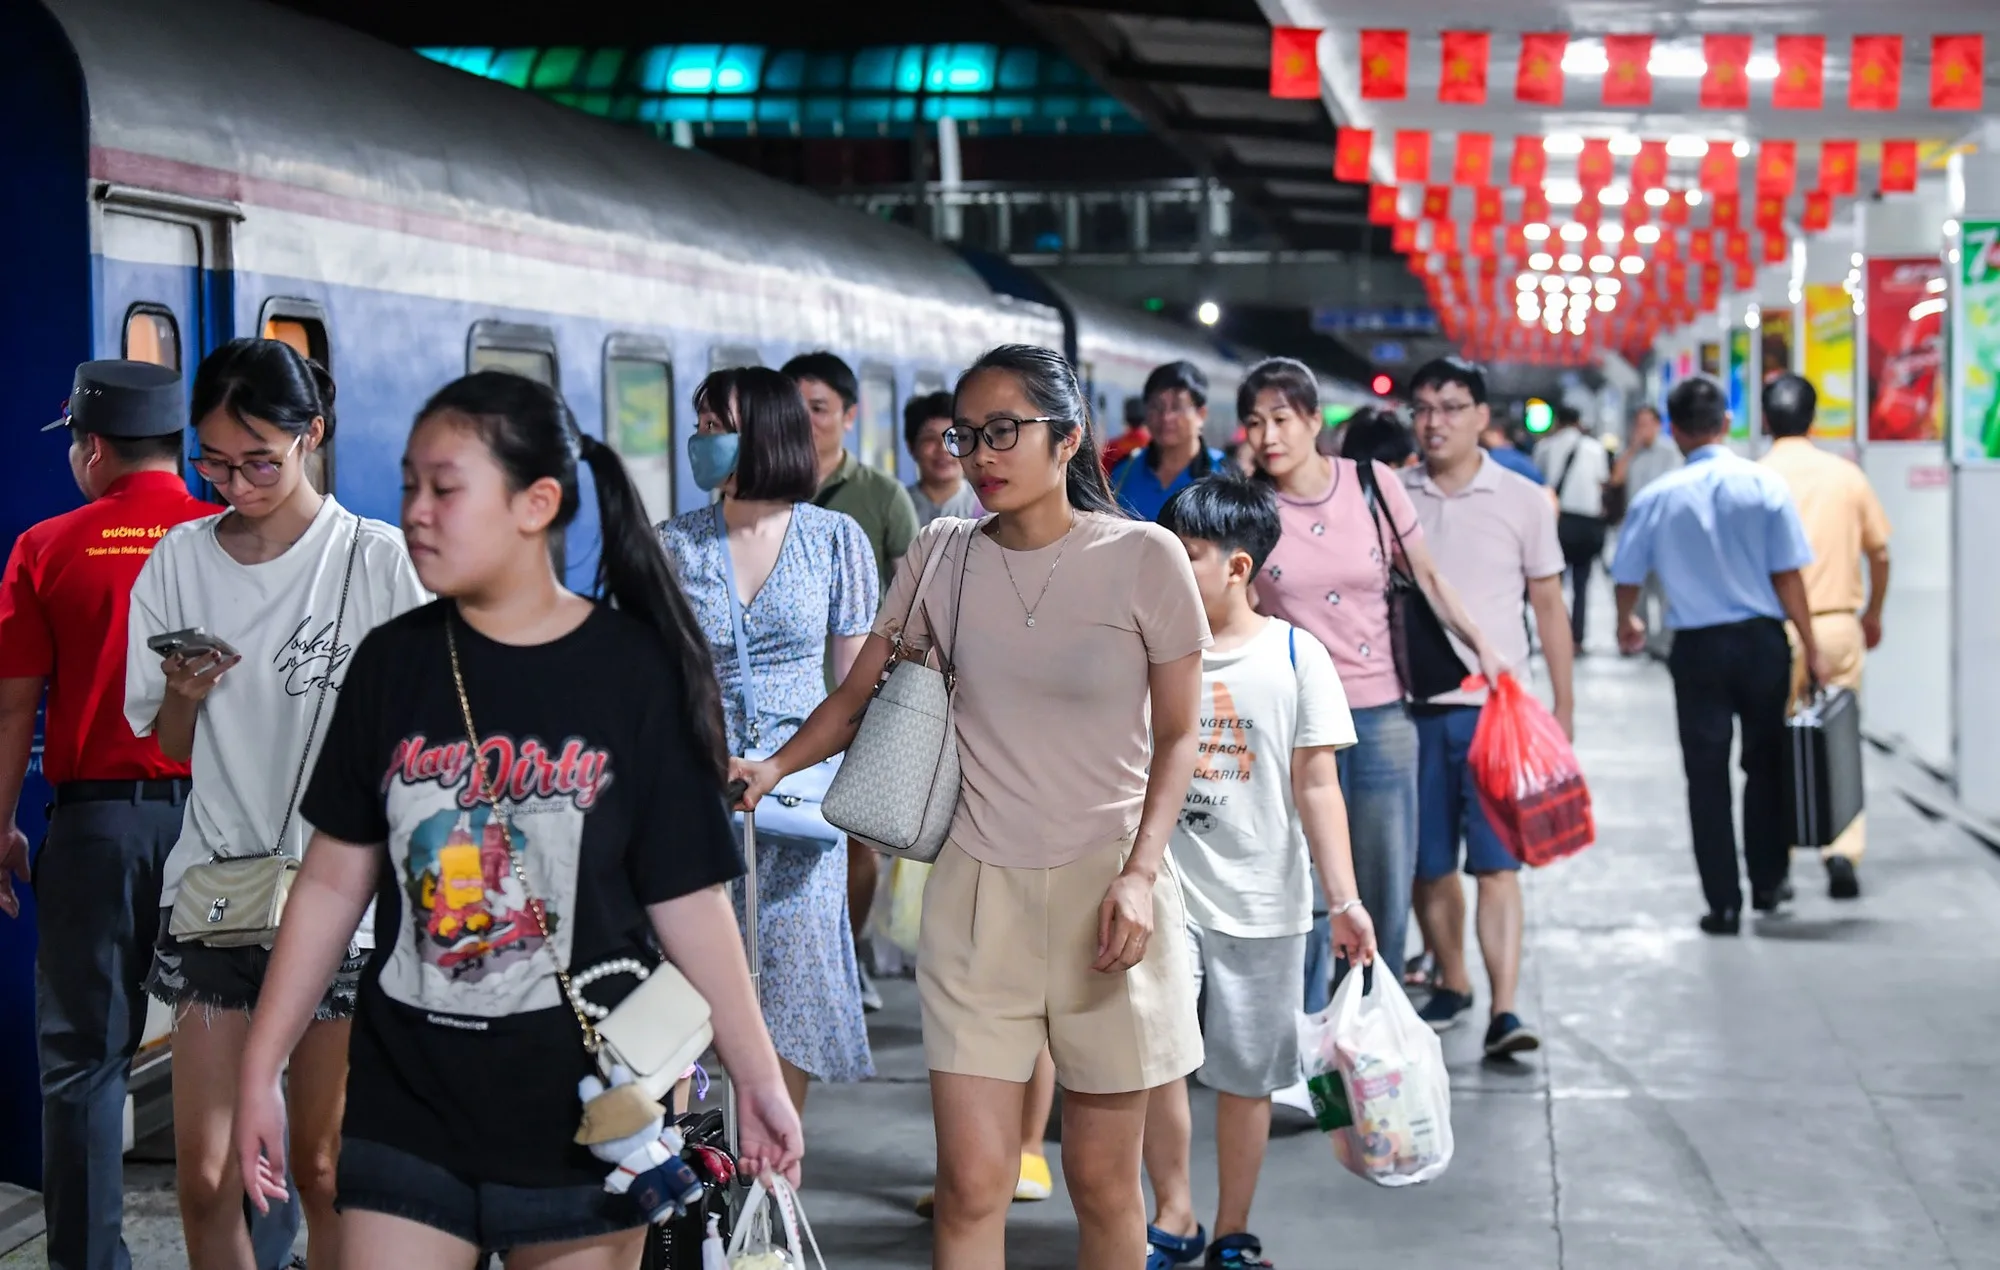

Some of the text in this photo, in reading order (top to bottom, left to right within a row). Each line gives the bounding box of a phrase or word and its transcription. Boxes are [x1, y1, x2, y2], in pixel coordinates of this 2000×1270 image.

[1199, 717, 1254, 730] NGELES
[1198, 742, 1248, 755] BEACH
[459, 735, 613, 809] Dirty
[1192, 768, 1251, 782] CLARITA
[1184, 792, 1229, 807] NDALE
